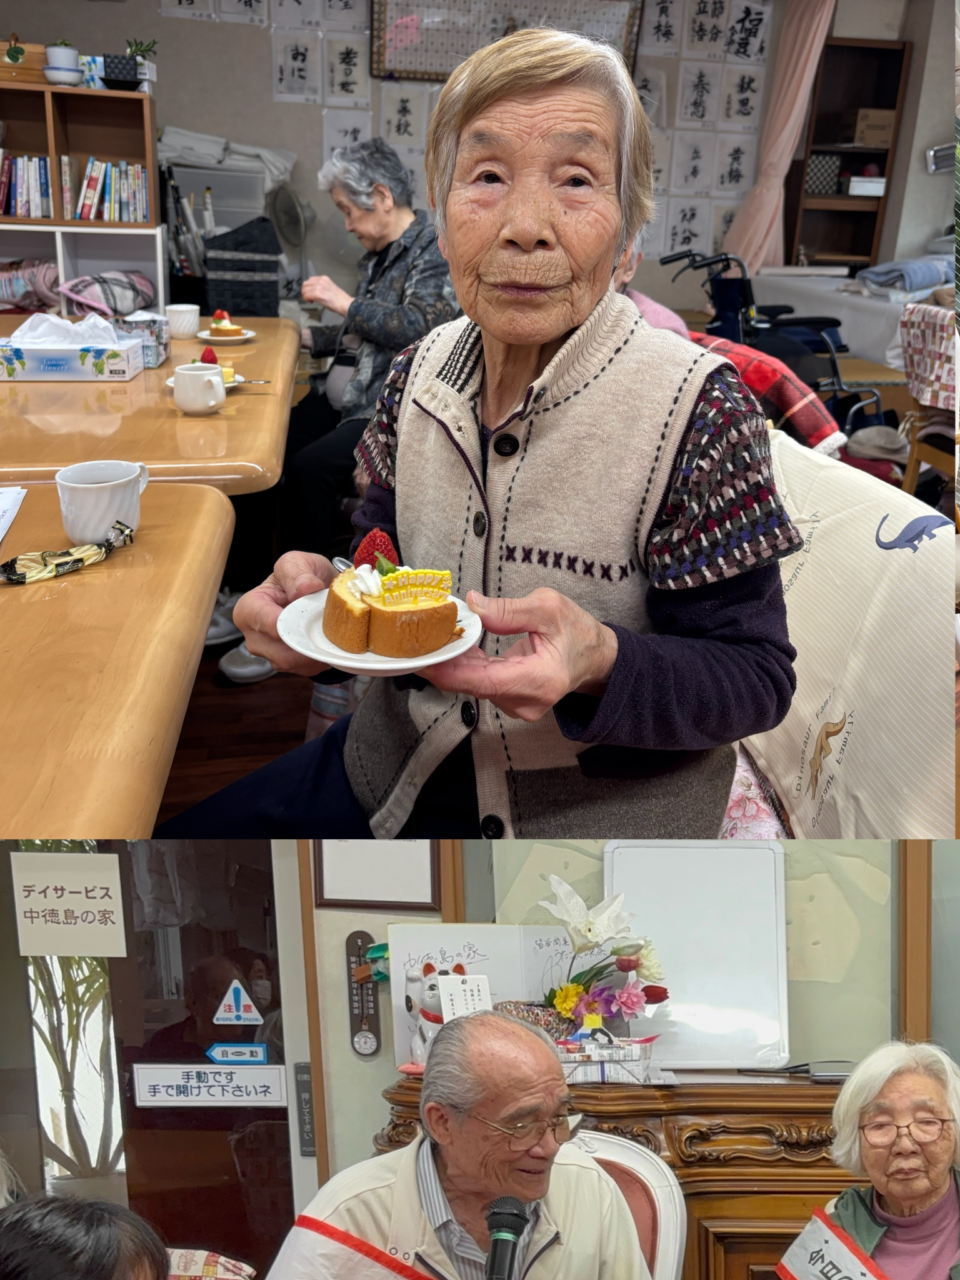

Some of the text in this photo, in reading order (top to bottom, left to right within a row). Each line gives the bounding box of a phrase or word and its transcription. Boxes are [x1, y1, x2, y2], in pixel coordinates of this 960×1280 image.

[291, 44, 308, 80] おに
[398, 573, 442, 587] Happy
[383, 586, 451, 605] Anniversary
[22, 885, 113, 900] デイサービス
[23, 907, 117, 926] 中徳島の家
[181, 1070, 236, 1084] 手動です
[148, 1084, 272, 1097] 手で開けて下さいネ
